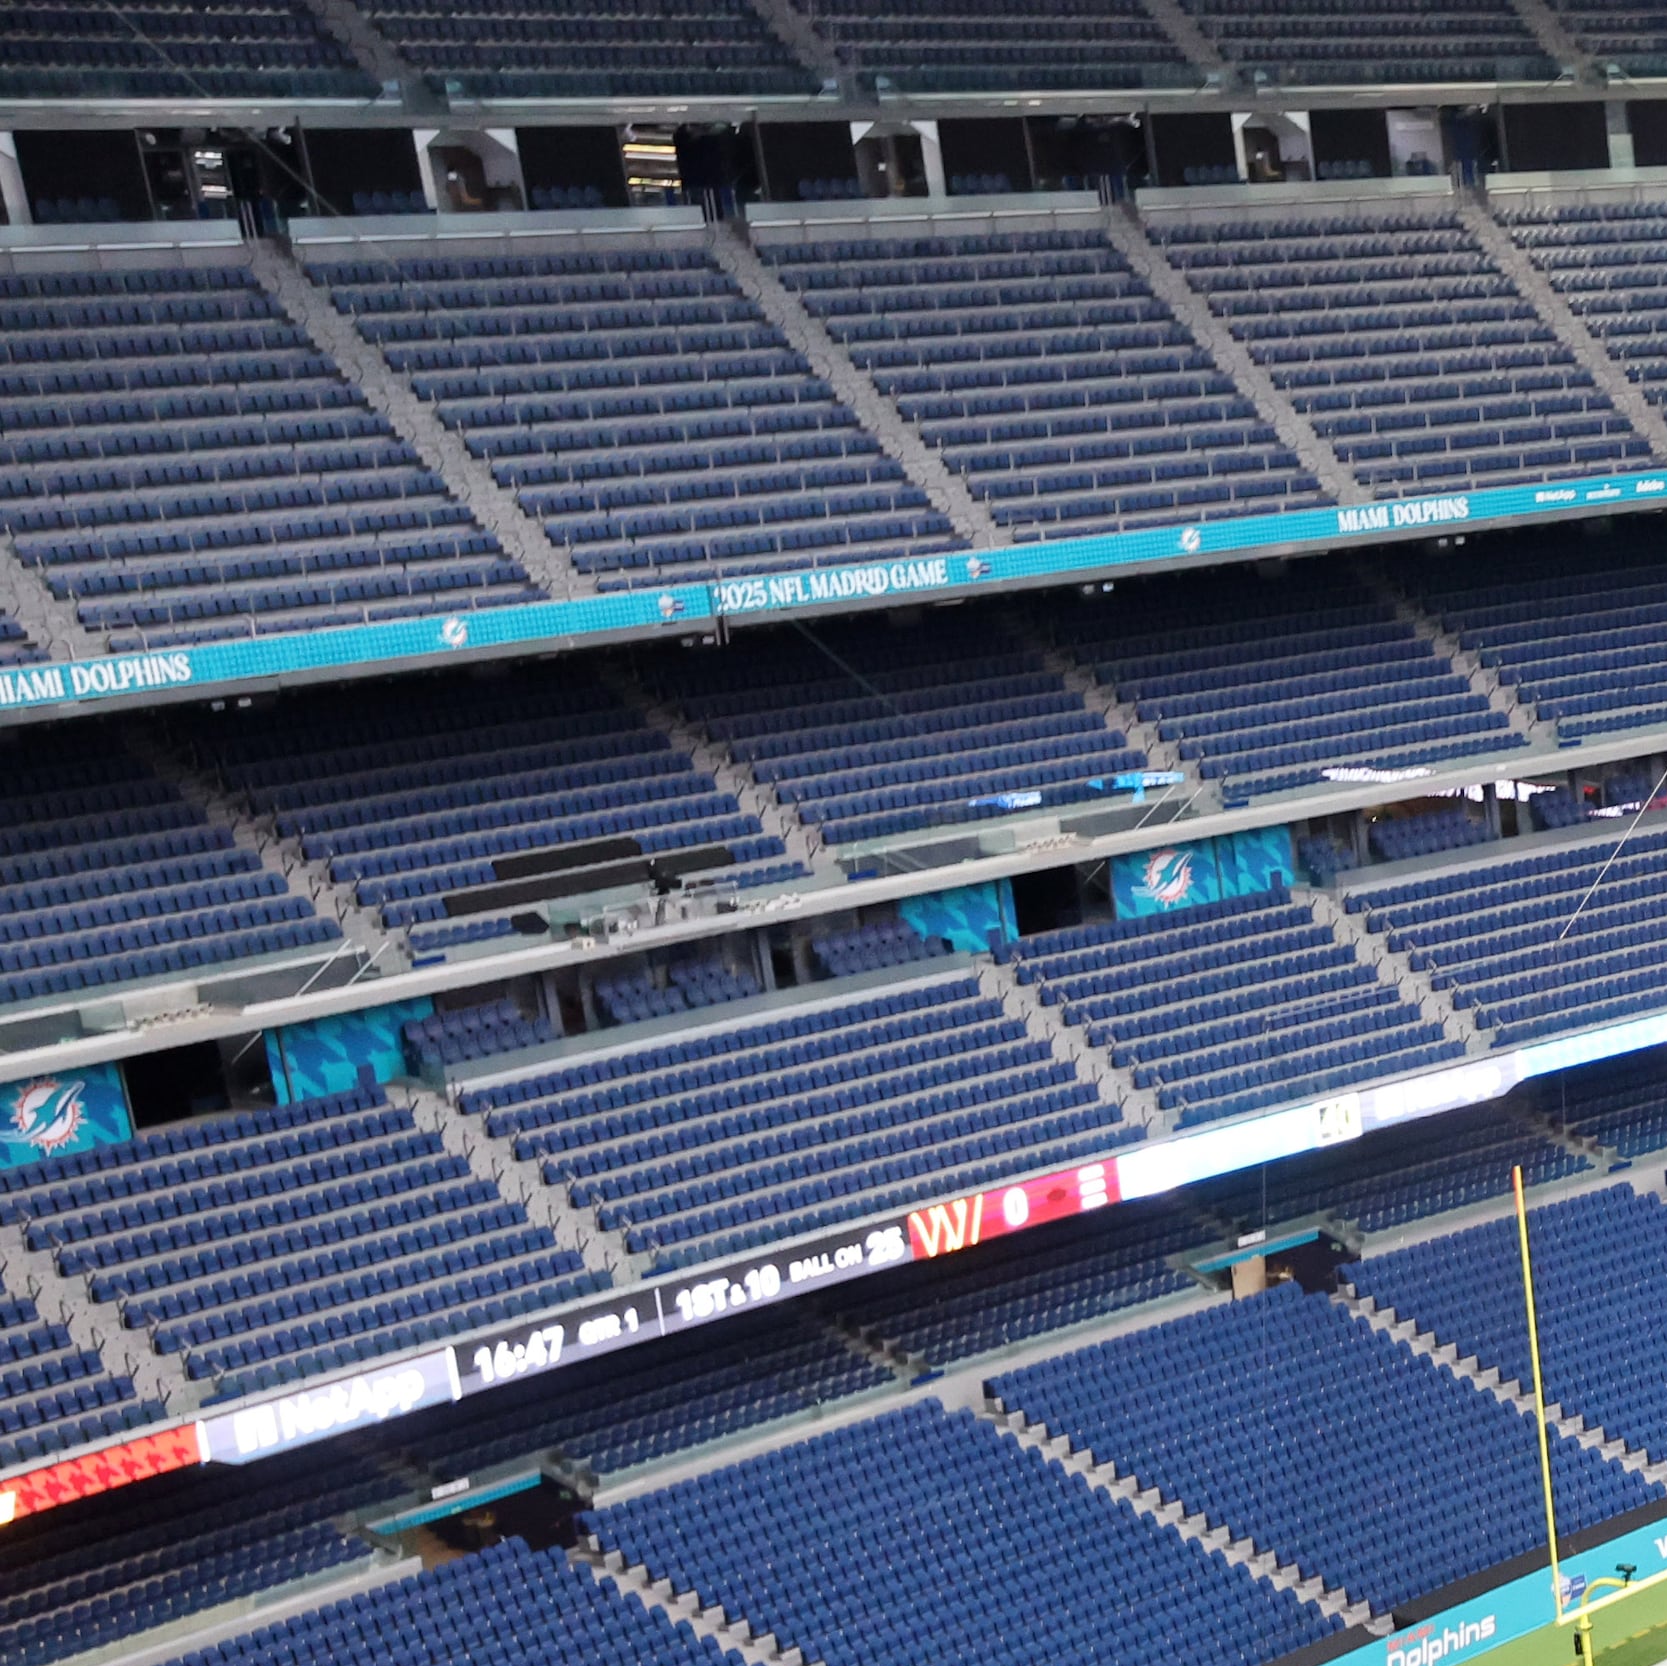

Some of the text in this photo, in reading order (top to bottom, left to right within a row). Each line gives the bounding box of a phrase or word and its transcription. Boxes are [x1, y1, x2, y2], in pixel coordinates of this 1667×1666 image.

[1338, 497, 1469, 534] MIAMI DOLPHINS
[713, 559, 948, 612] 2025 NFL MADRID GAME
[70, 652, 192, 696] DOLPHINS
[1387, 1622, 1436, 1652] MIAMI
